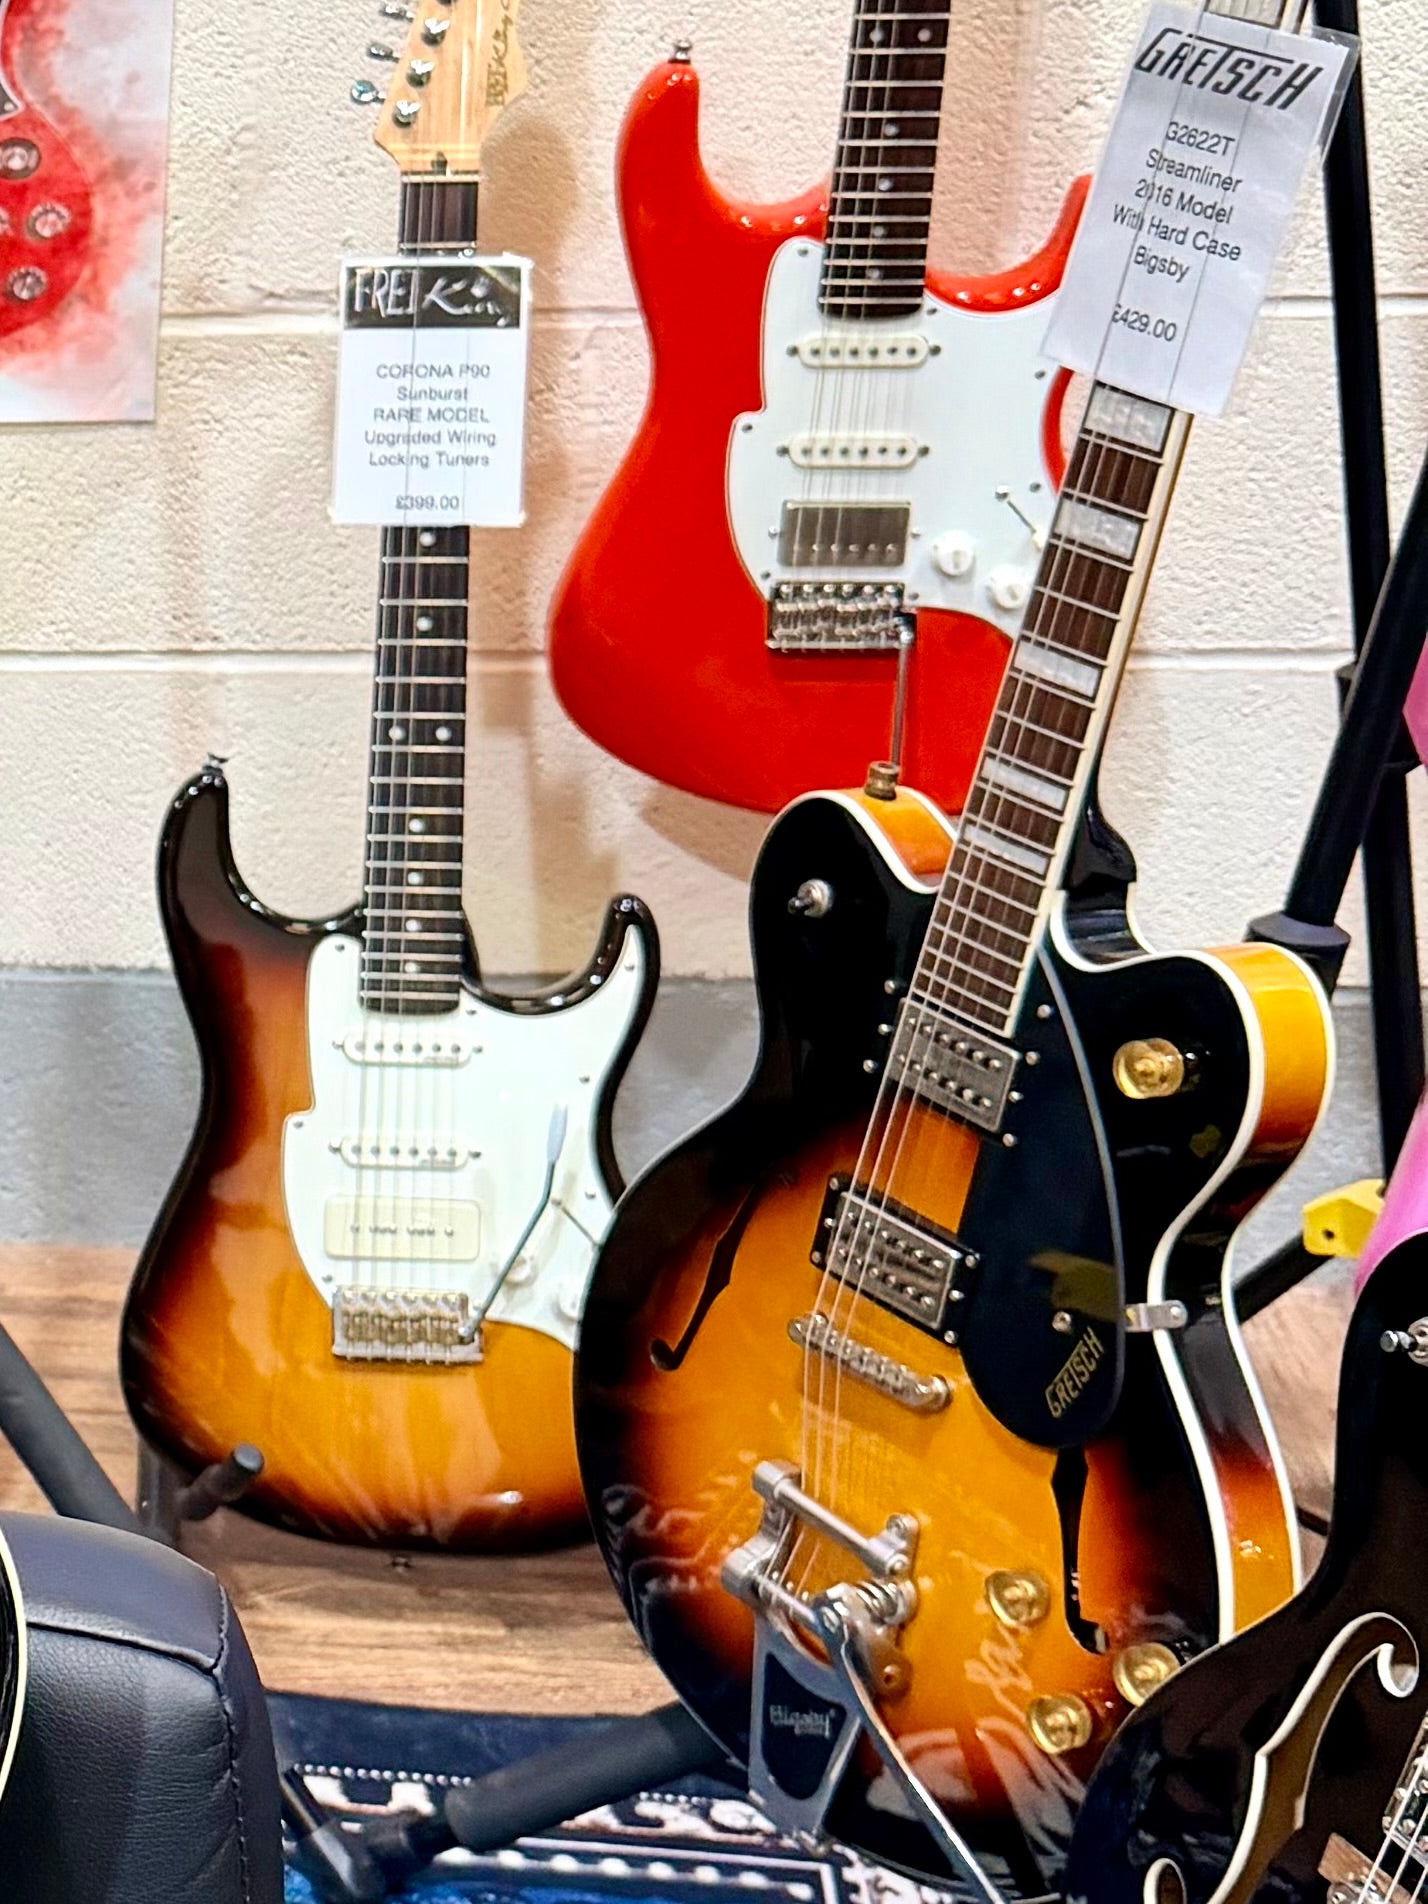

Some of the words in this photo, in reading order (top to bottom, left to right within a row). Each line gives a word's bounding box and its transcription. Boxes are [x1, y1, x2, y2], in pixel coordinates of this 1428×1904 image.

[1134, 27, 1325, 111] GRETSCH
[1166, 121, 1236, 157] G2622T
[1146, 149, 1243, 195] Streamliner
[1134, 178, 1173, 206] 2016
[1176, 191, 1234, 225] Model
[1113, 203, 1146, 235] With
[1149, 215, 1187, 247] Hard
[1192, 230, 1242, 262] Case
[1134, 245, 1190, 284] Bigsby
[1111, 303, 1177, 343] £429.00
[376, 363, 453, 379] CORONA
[459, 363, 490, 378] P90
[397, 386, 468, 401] Sunburst
[373, 408, 423, 422] RARE
[427, 407, 491, 422] MODEL
[365, 429, 441, 446] Upgraded
[447, 428, 496, 446] Wiring
[369, 451, 430, 469] Locking
[436, 451, 489, 466] Tuners
[396, 495, 459, 511] £399.00
[1045, 1325, 1104, 1418] GRETSCH
